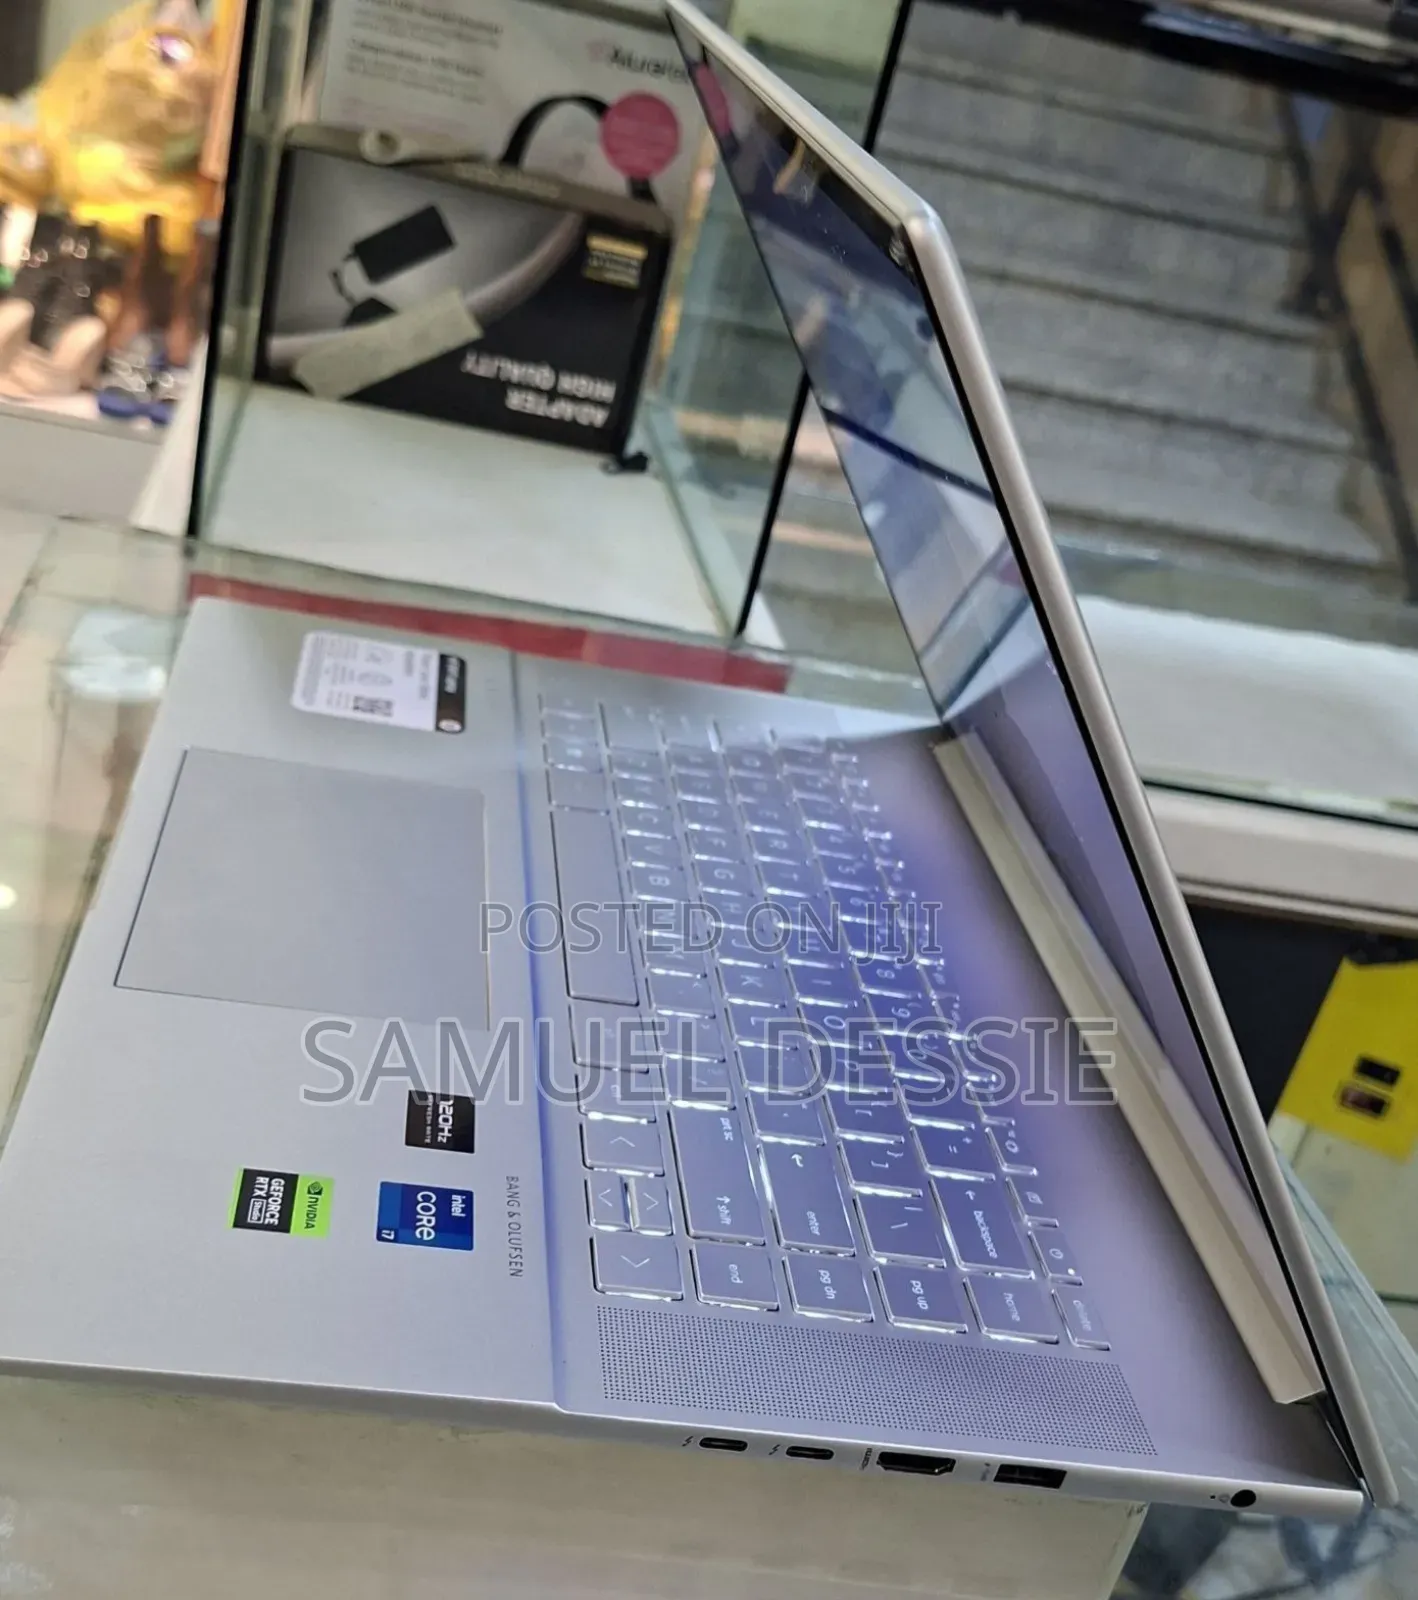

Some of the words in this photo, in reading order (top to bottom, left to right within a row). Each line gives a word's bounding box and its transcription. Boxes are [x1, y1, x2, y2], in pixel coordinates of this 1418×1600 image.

[460, 351, 556, 391] QUALITY
[557, 370, 616, 403] HIGH
[648, 875, 670, 887] B
[255, 1176, 270, 1198] RTX
[505, 1175, 521, 1209] BANG
[249, 1200, 265, 1222] Studio
[264, 1177, 286, 1226] GEFORCE
[451, 1193, 466, 1218] intel
[717, 1204, 732, 1225] shift
[806, 1210, 821, 1236] enter
[381, 1228, 395, 1241] i7
[973, 1210, 998, 1259] backspace
[508, 1220, 524, 1278] OLUFSEN
[728, 1263, 744, 1284] end
[818, 1268, 832, 1284] pg
[824, 1285, 837, 1300] dn
[910, 1279, 924, 1295] pg
[917, 1295, 929, 1311] up
[1003, 1291, 1021, 1322] home
